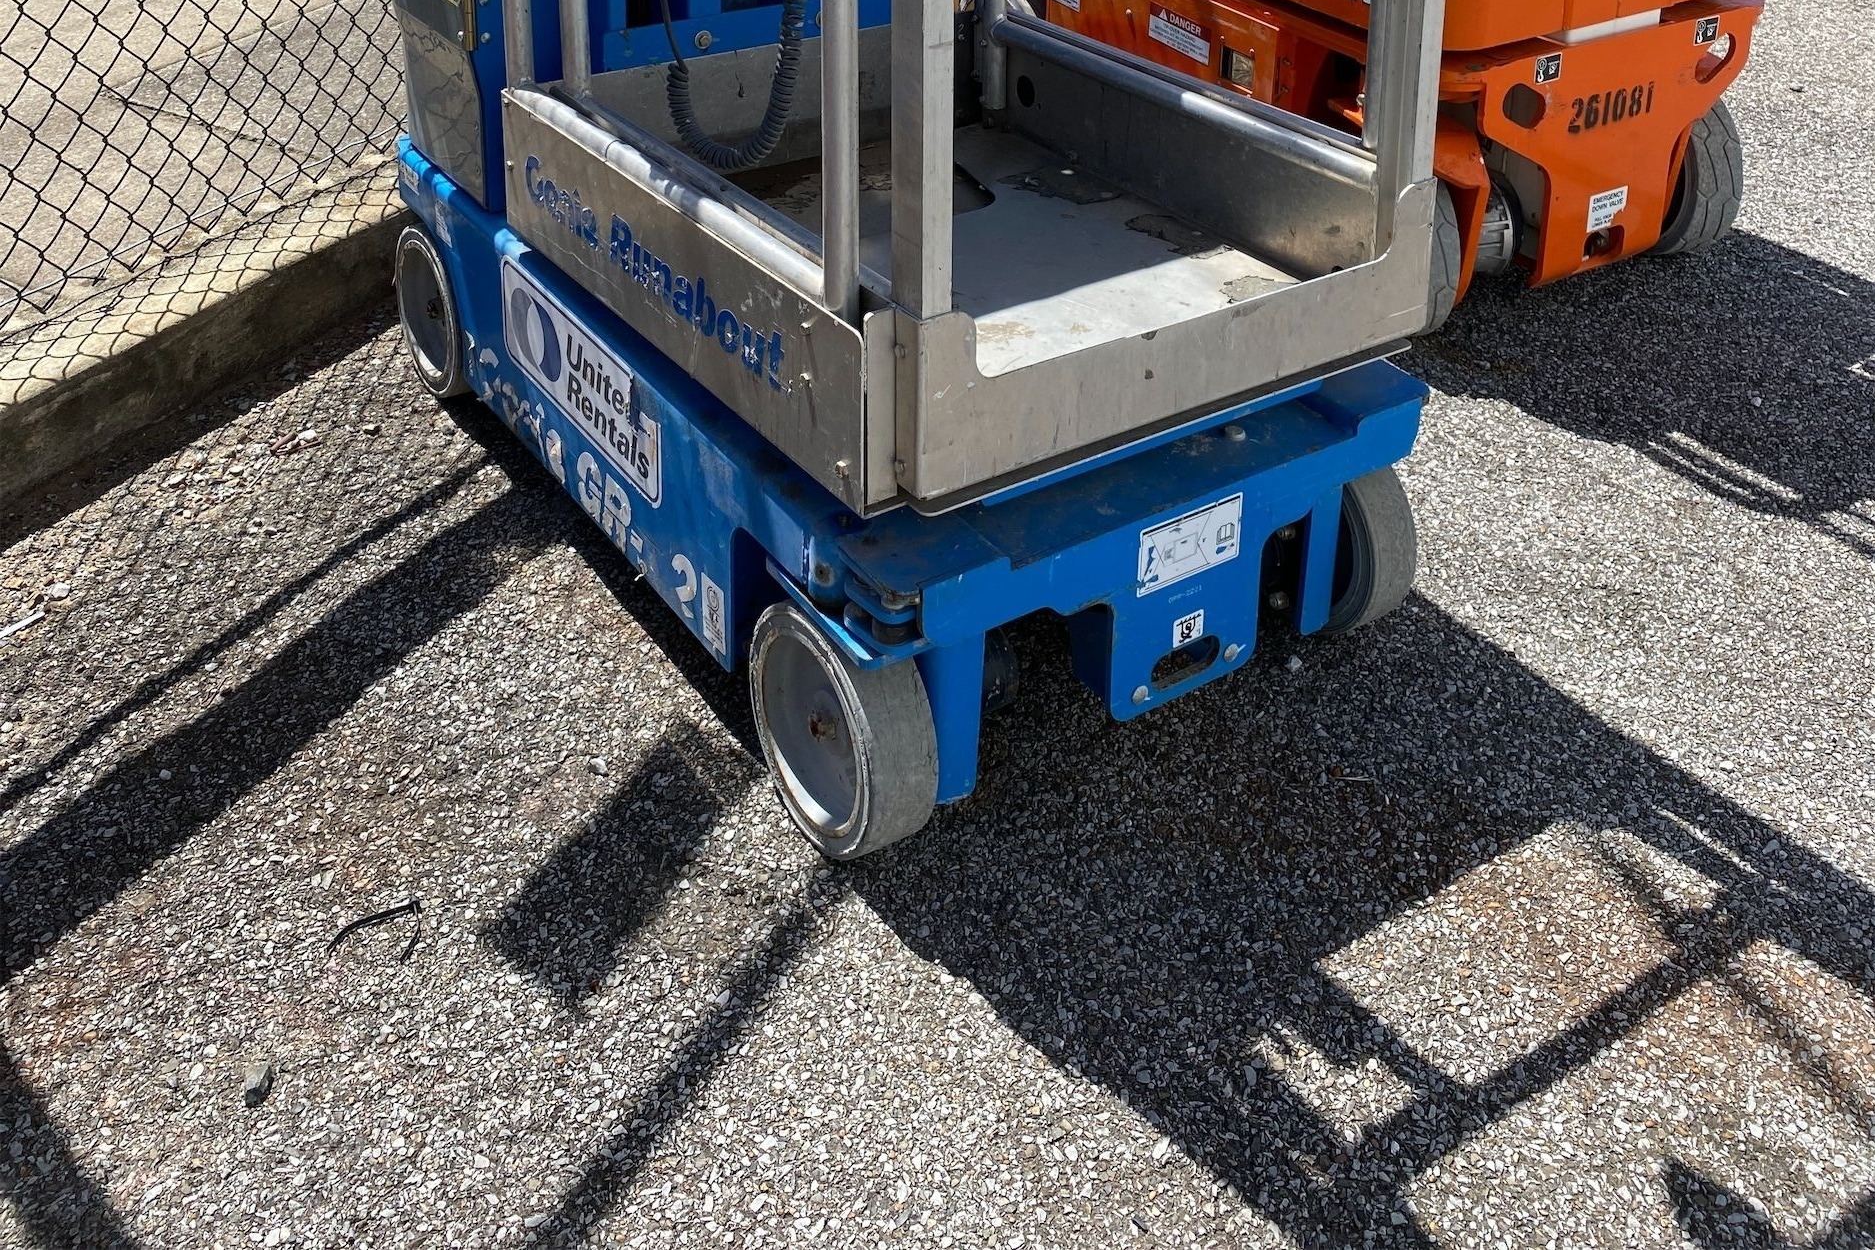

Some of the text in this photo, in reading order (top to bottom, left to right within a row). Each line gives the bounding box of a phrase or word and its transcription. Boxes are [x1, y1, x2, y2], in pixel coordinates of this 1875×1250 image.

[1169, 13, 1202, 36] DANGER
[1567, 81, 1656, 134] 261081
[1591, 202, 1608, 213] DOWN
[1593, 190, 1624, 205] EMERGENCY
[609, 212, 786, 392] Runabout
[567, 371, 650, 480] Rentals
